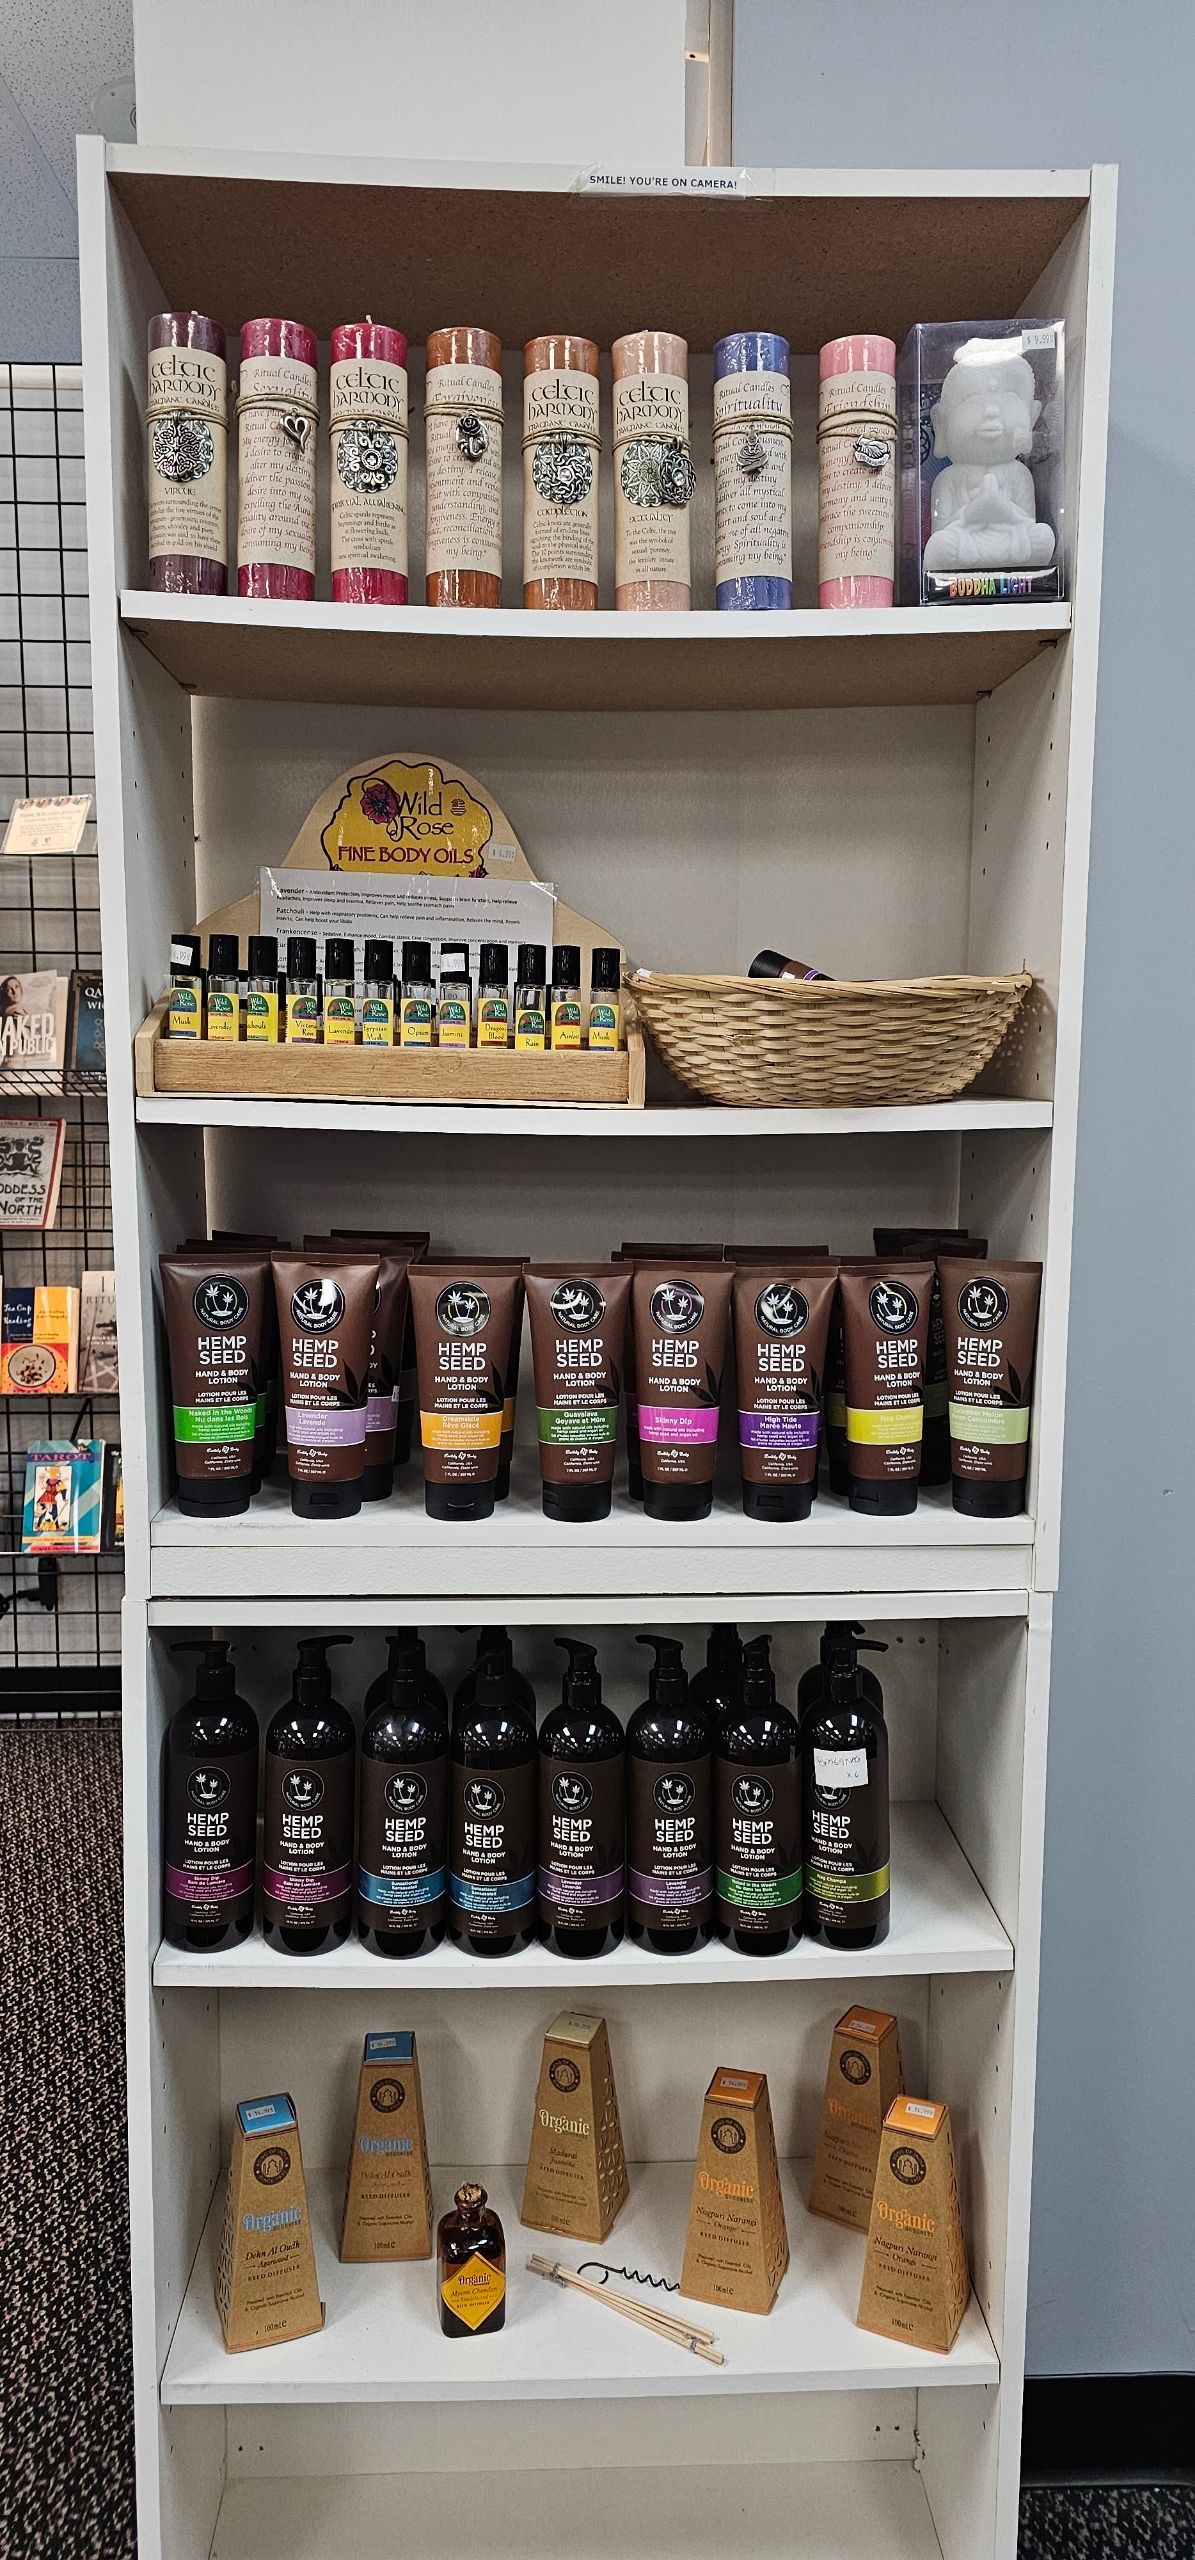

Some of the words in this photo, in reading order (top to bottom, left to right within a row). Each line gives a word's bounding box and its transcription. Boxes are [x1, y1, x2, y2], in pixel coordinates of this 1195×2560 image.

[590, 175, 626, 184] SMILE!
[630, 177, 668, 186] YOU'RE
[672, 178, 687, 186] ON
[691, 179, 737, 189] CAMERA!
[254, 367, 281, 379] Ritual
[283, 371, 312, 387] Candles
[438, 377, 464, 388] Ritual
[466, 377, 495, 392] Candles
[719, 382, 741, 399] Ritual
[743, 383, 775, 392] Candles
[829, 382, 852, 398] Ritual
[856, 382, 886, 394] Candles
[715, 393, 782, 420] Spirituality
[949, 577, 996, 596] BUDDHA
[1000, 576, 1033, 594] LIGHT
[399, 791, 442, 816] Wild
[393, 816, 454, 842] Rose
[338, 846, 376, 861] FINE
[378, 847, 429, 863] BODY
[434, 848, 474, 864] OILS
[173, 1016, 191, 1025] Musk
[10, 1037, 53, 1055] PUBLIC
[525, 1038, 539, 1046] Rain
[198, 1336, 247, 1350] HEMP
[292, 1338, 339, 1353] HEMP
[439, 1343, 487, 1356] HEMP
[556, 1339, 603, 1353] HEMP
[652, 1340, 700, 1353] HEMP
[876, 1340, 918, 1354] HEMP
[958, 1337, 1002, 1352] HEMP
[199, 1350, 246, 1365] SEED
[758, 1344, 806, 1357] HEMP
[293, 1353, 337, 1368] SEED
[439, 1357, 486, 1371] SEED
[557, 1353, 602, 1367] SEED
[652, 1353, 698, 1368] SEED
[759, 1358, 805, 1372] SEED
[878, 1353, 917, 1368] SEED
[958, 1352, 1000, 1367] SEED
[195, 1370, 219, 1378] HAND
[208, 1376, 238, 1385] LOTION
[649, 1377, 670, 1385] HAND
[679, 1378, 701, 1386] BODY
[964, 1378, 991, 1386] LOTION
[660, 1385, 689, 1393] LOTION
[655, 1417, 678, 1425] Skinny
[679, 1417, 692, 1425] Dip
[187, 1813, 229, 1825] HEMP
[282, 1815, 323, 1827] HEMP
[385, 1818, 426, 1831] HEMP
[552, 1815, 592, 1830] HEMP
[655, 1818, 696, 1831] HEMP
[732, 1818, 774, 1832] HEMP
[812, 1810, 850, 1827] HEMP
[188, 1824, 227, 1837] SEED
[283, 1827, 322, 1840] SEED
[386, 1830, 424, 1842] SEED
[465, 1822, 504, 1836] HEMP
[553, 1828, 591, 1842] SEED
[813, 1824, 849, 1839] SEED
[466, 1835, 503, 1849] SEED
[656, 1831, 694, 1843] SEED
[734, 1830, 772, 1845] SEED
[539, 2108, 589, 2135] Organic
[699, 2171, 754, 2198] Organic
[878, 2200, 935, 2233] Organic
